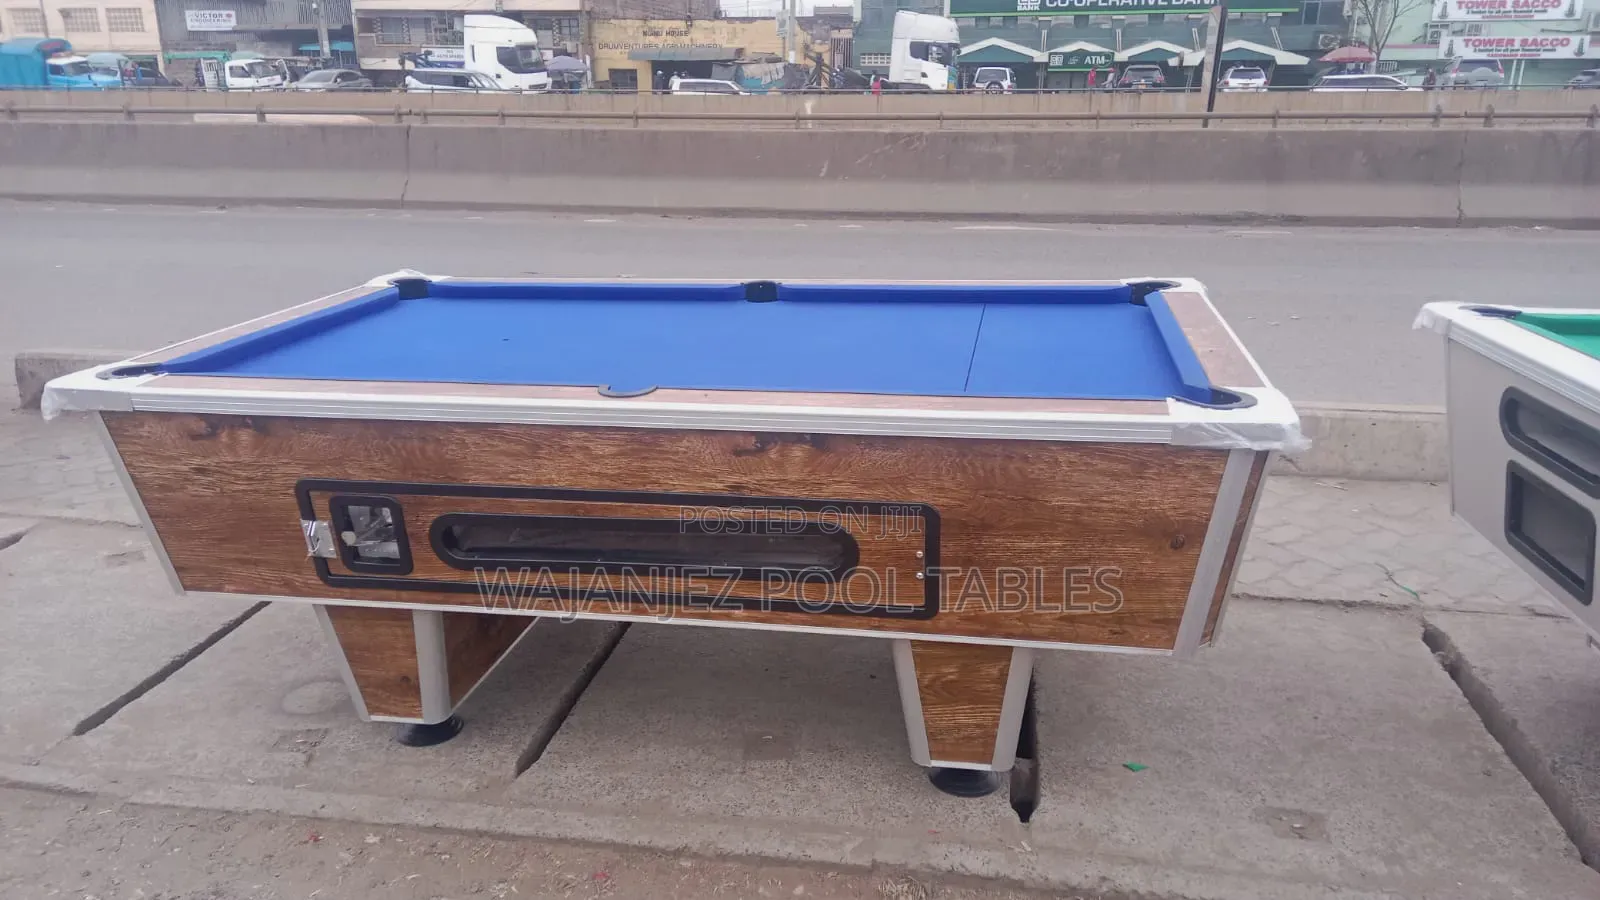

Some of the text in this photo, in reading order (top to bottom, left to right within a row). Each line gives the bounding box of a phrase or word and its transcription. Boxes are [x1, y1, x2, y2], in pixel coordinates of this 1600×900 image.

[1456, 0, 1561, 10] TOWER SACCO
[1464, 38, 1570, 48] TOWER SACCO
[1084, 55, 1105, 65] ATM
